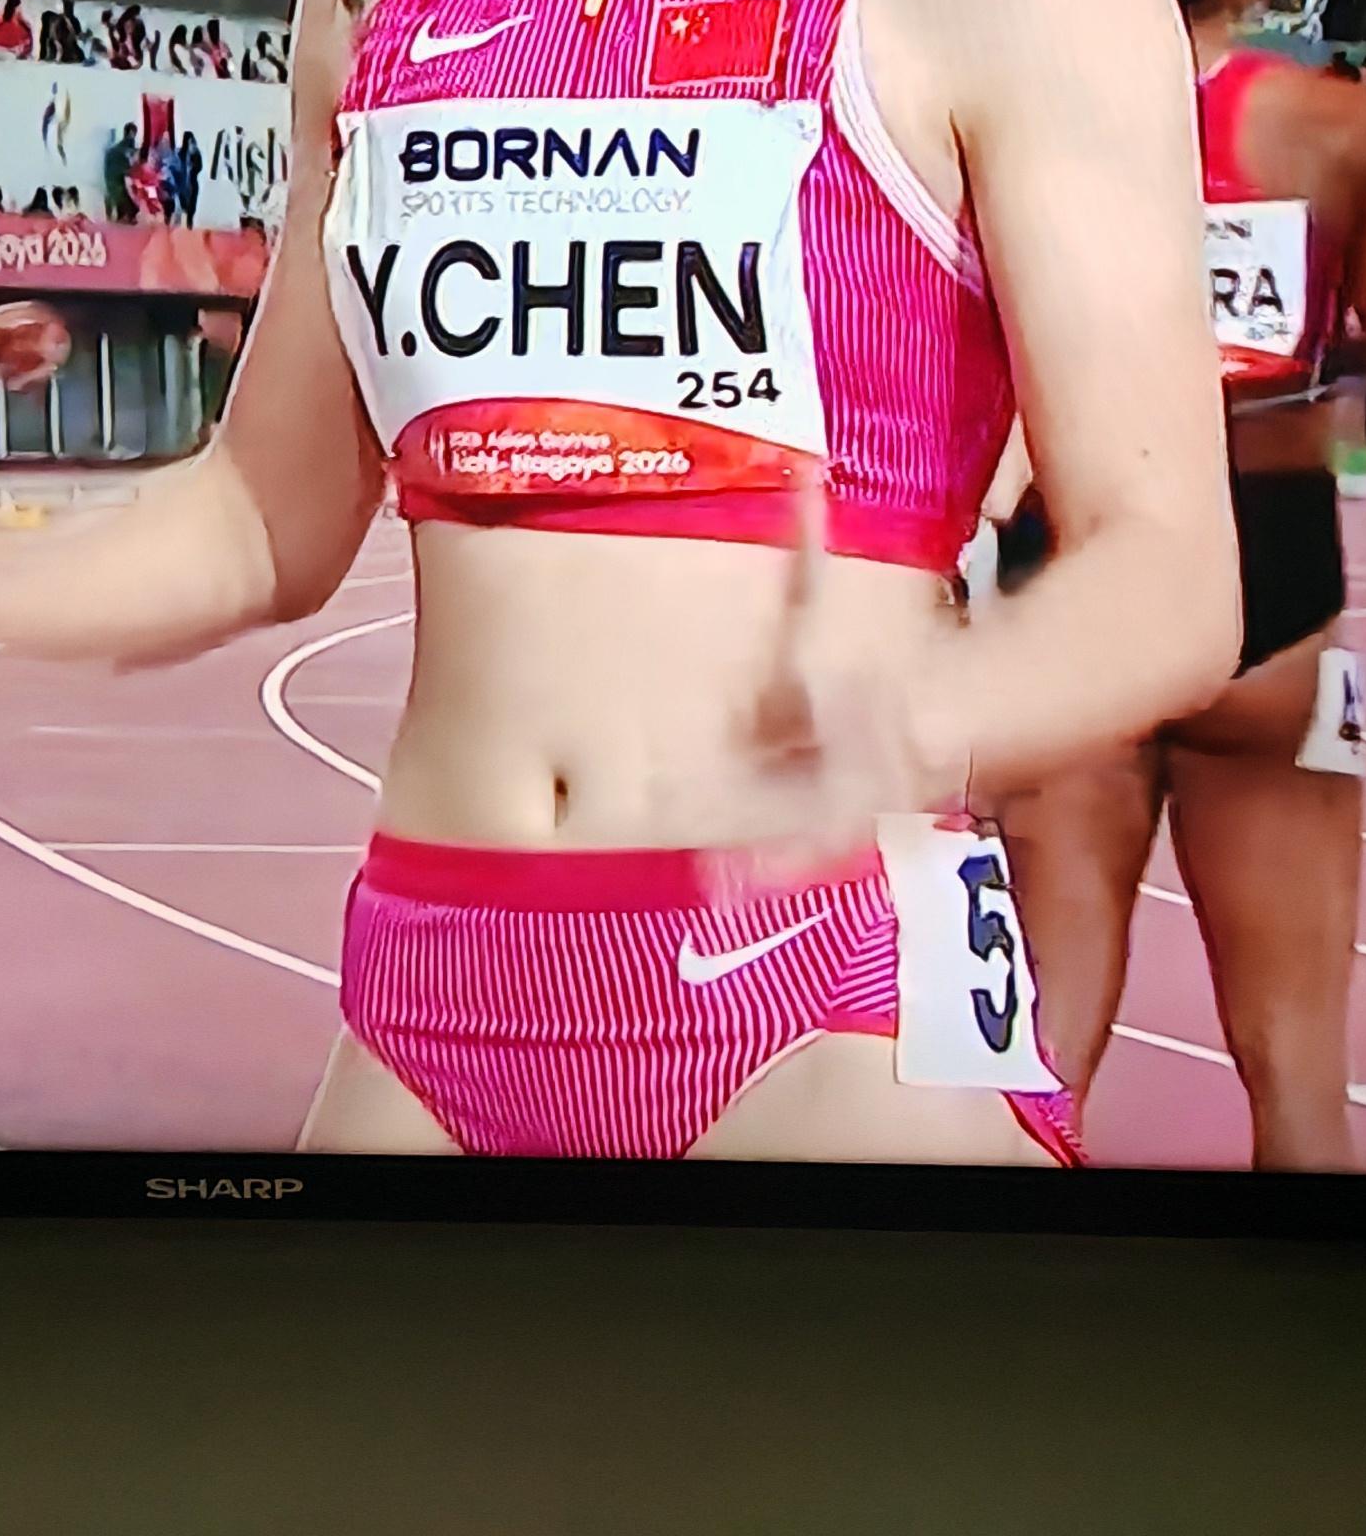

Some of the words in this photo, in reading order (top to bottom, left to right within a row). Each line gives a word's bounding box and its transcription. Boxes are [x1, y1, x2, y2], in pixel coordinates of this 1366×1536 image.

[398, 126, 701, 183] BORNAN
[400, 191, 496, 218] SPORTS
[507, 186, 693, 216] TECHNOLOGY
[47, 226, 108, 268] 2026
[345, 239, 768, 358] Y.CHEN
[676, 368, 782, 410] 254
[618, 449, 691, 476] 2026
[956, 853, 1019, 1054] 5
[144, 1177, 304, 1201] SHARP
